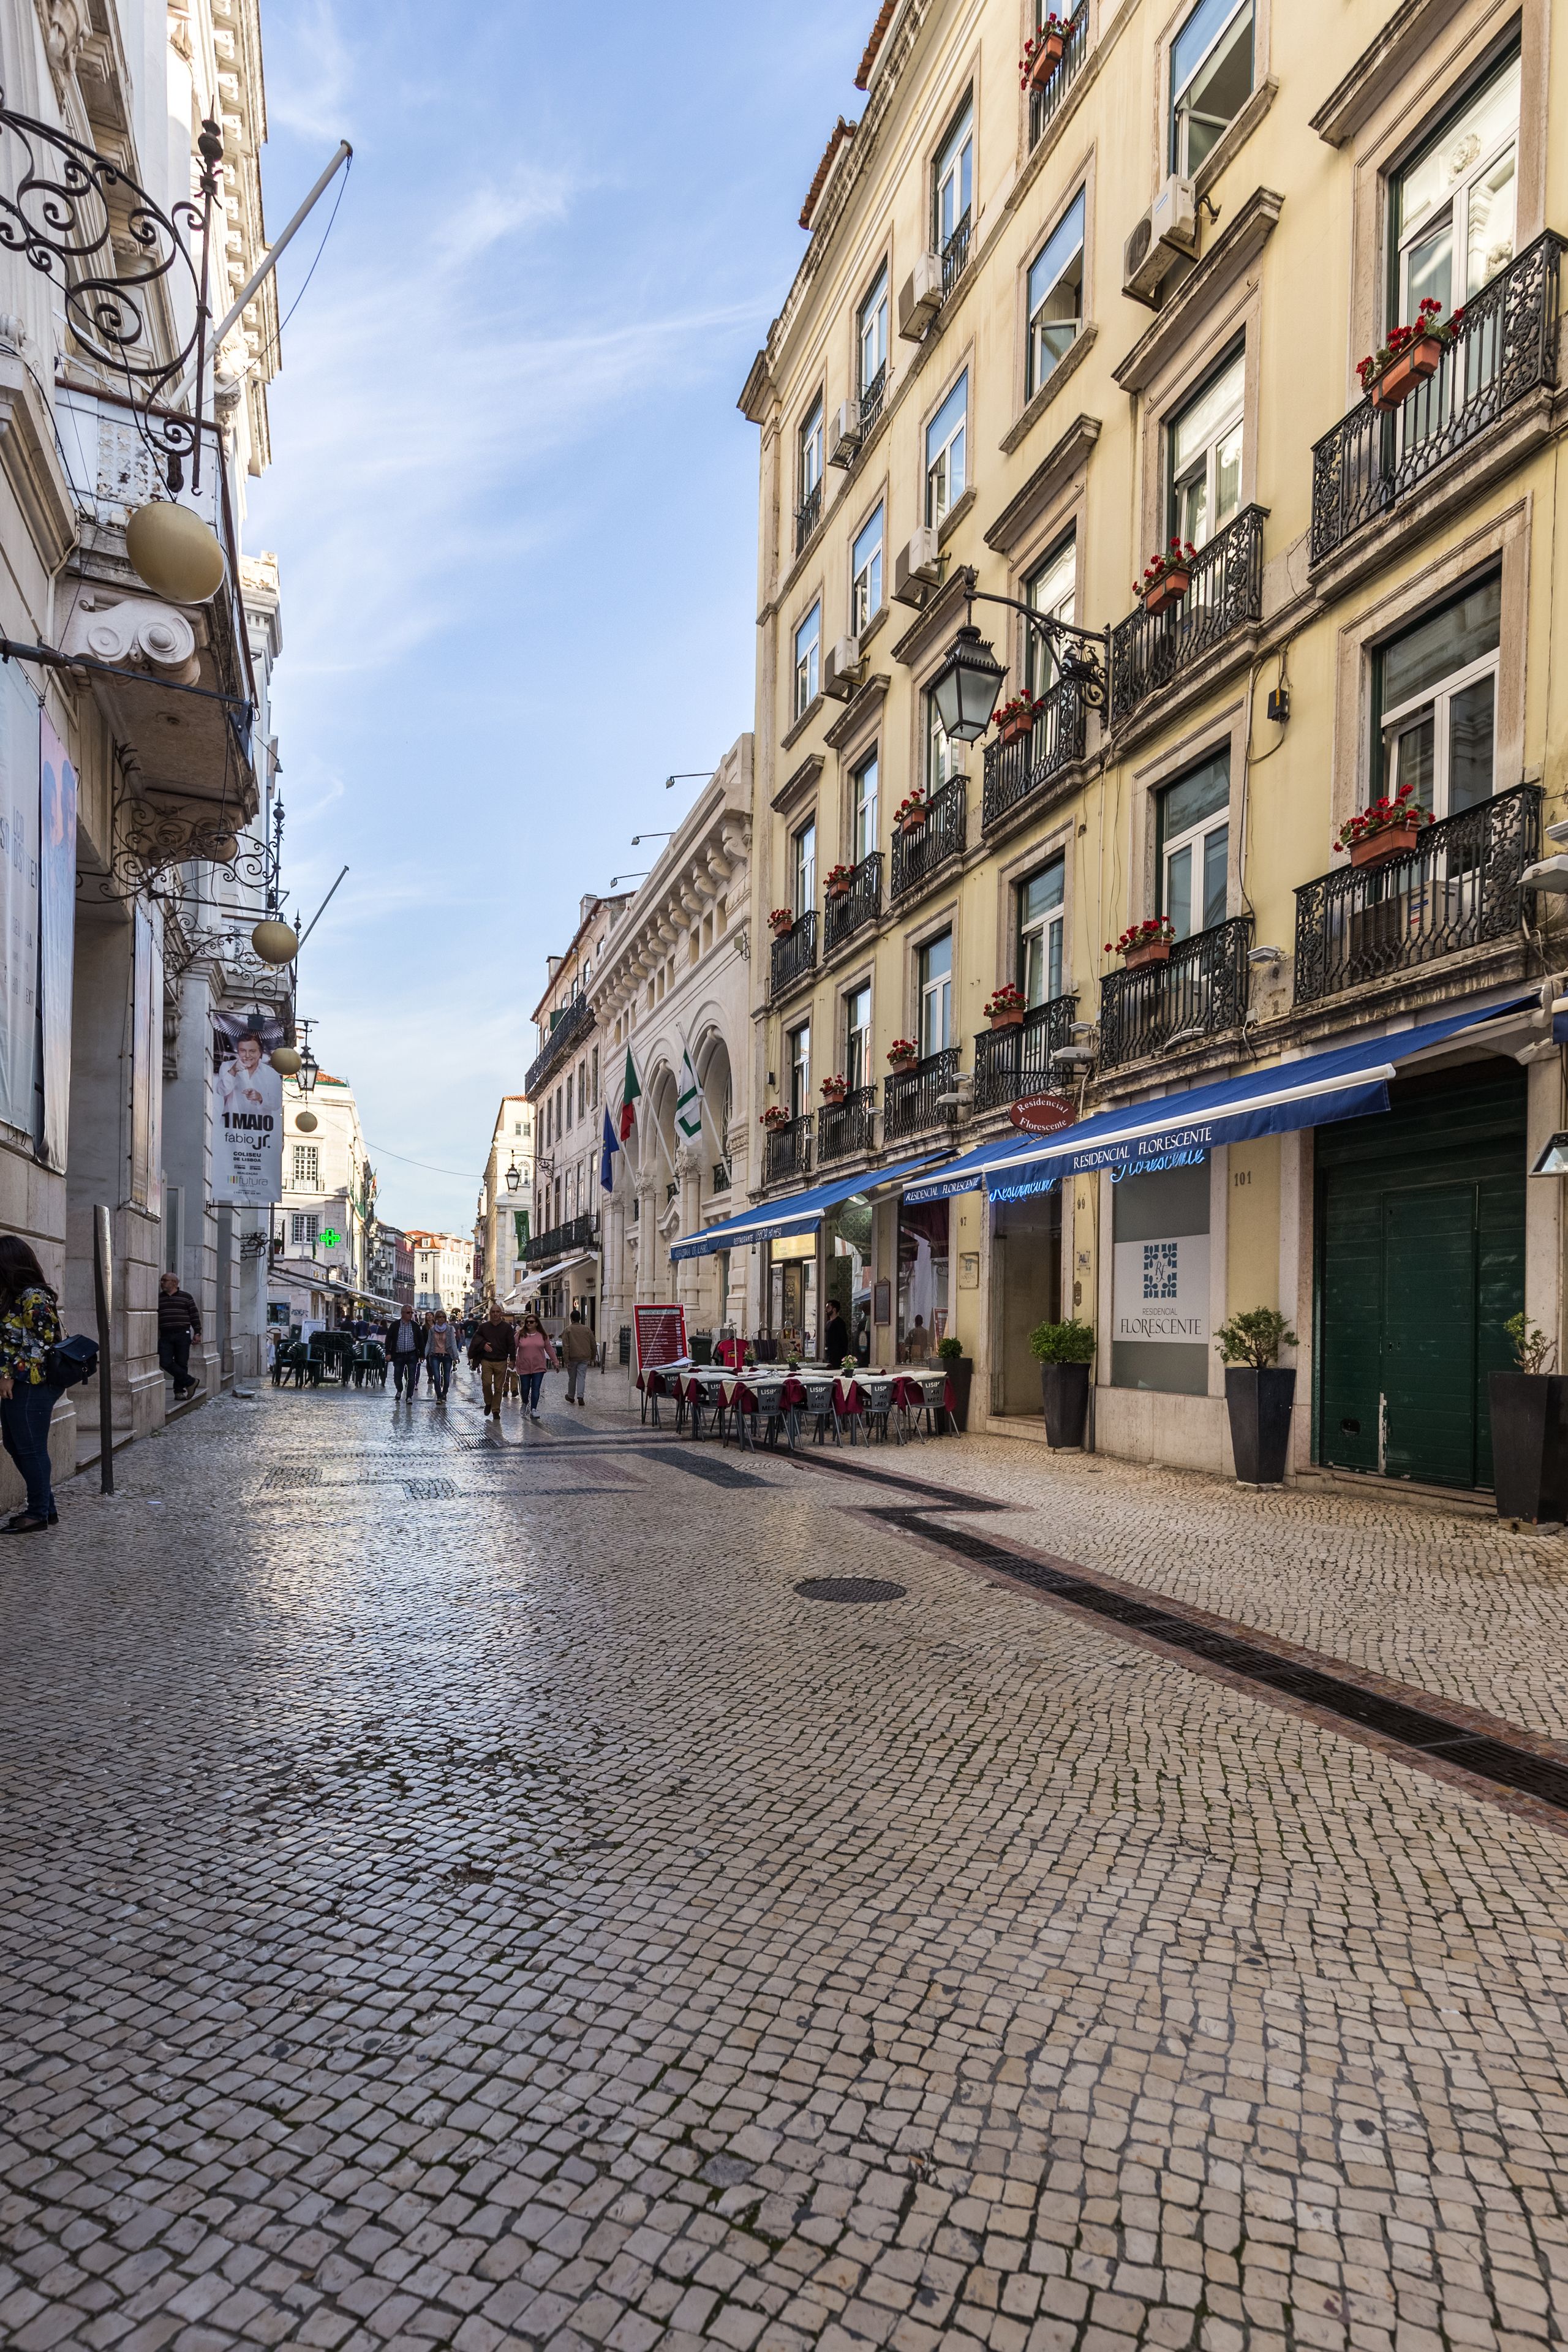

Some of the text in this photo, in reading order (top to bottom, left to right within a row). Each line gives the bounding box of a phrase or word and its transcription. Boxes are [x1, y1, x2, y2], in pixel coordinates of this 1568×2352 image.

[1017, 1098, 1069, 1114] Residencial
[222, 1112, 274, 1131] 1 MAIO
[1019, 1117, 1067, 1131] Florescente
[1074, 1126, 1212, 1169] RESIDENCIAL FLORESCENTE
[239, 1175, 268, 1186] futura
[1234, 1170, 1251, 1187] 101
[905, 1176, 980, 1201] RESIDENCIAL FLORESCENTE
[1077, 1197, 1085, 1210] 99
[960, 1217, 967, 1226] 97
[698, 1244, 710, 1254] LISBO
[1079, 1254, 1087, 1263] AL
[1121, 1319, 1202, 1338] FLORESCENTE
